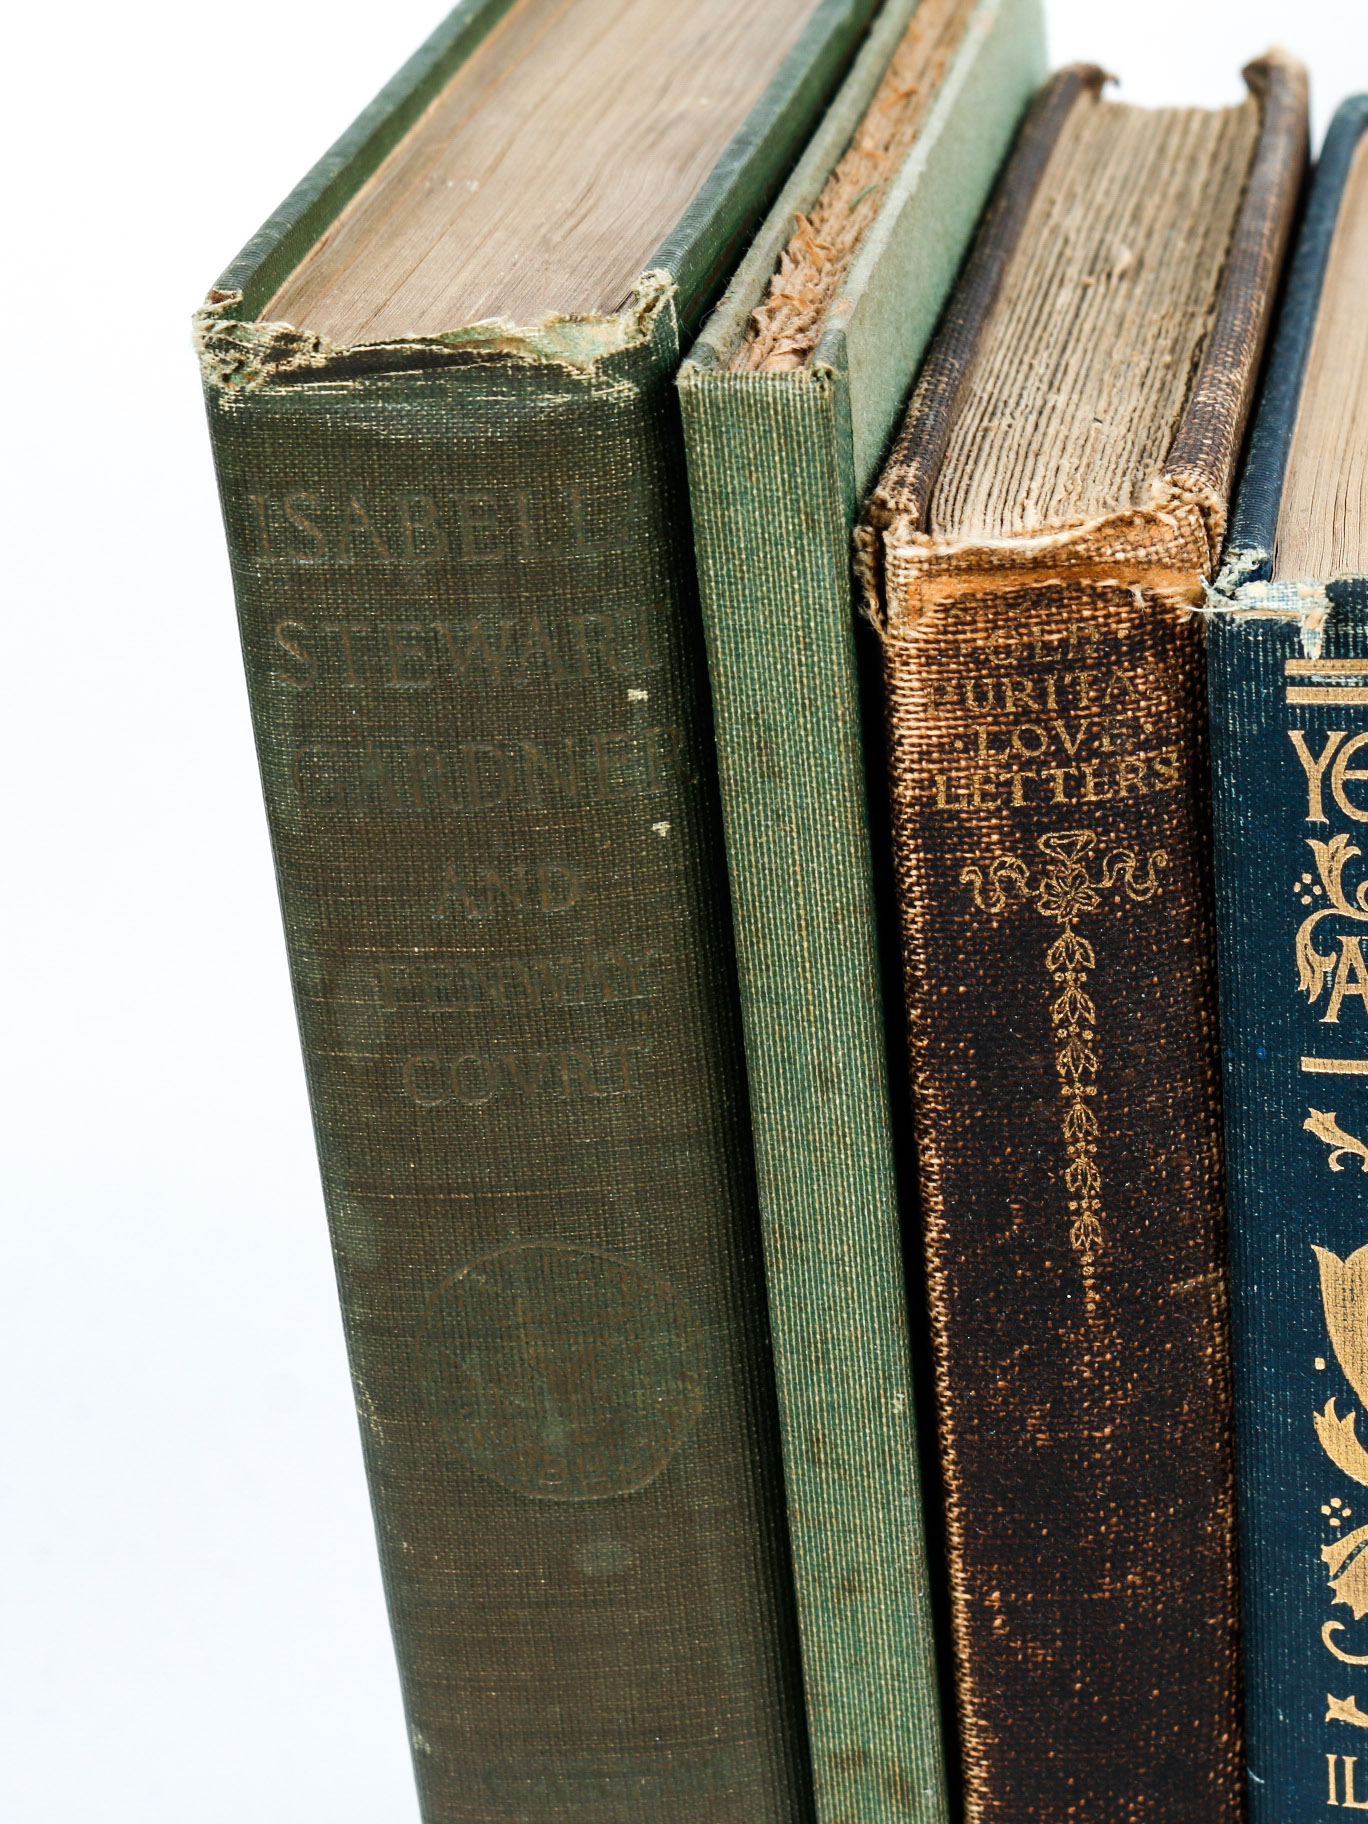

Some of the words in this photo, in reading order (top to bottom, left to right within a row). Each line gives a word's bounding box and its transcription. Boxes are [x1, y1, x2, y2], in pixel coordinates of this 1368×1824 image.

[248, 485, 655, 563] ISABELL
[274, 603, 668, 689] STEWART
[934, 751, 1180, 811] LETTERS
[433, 863, 579, 920] AND
